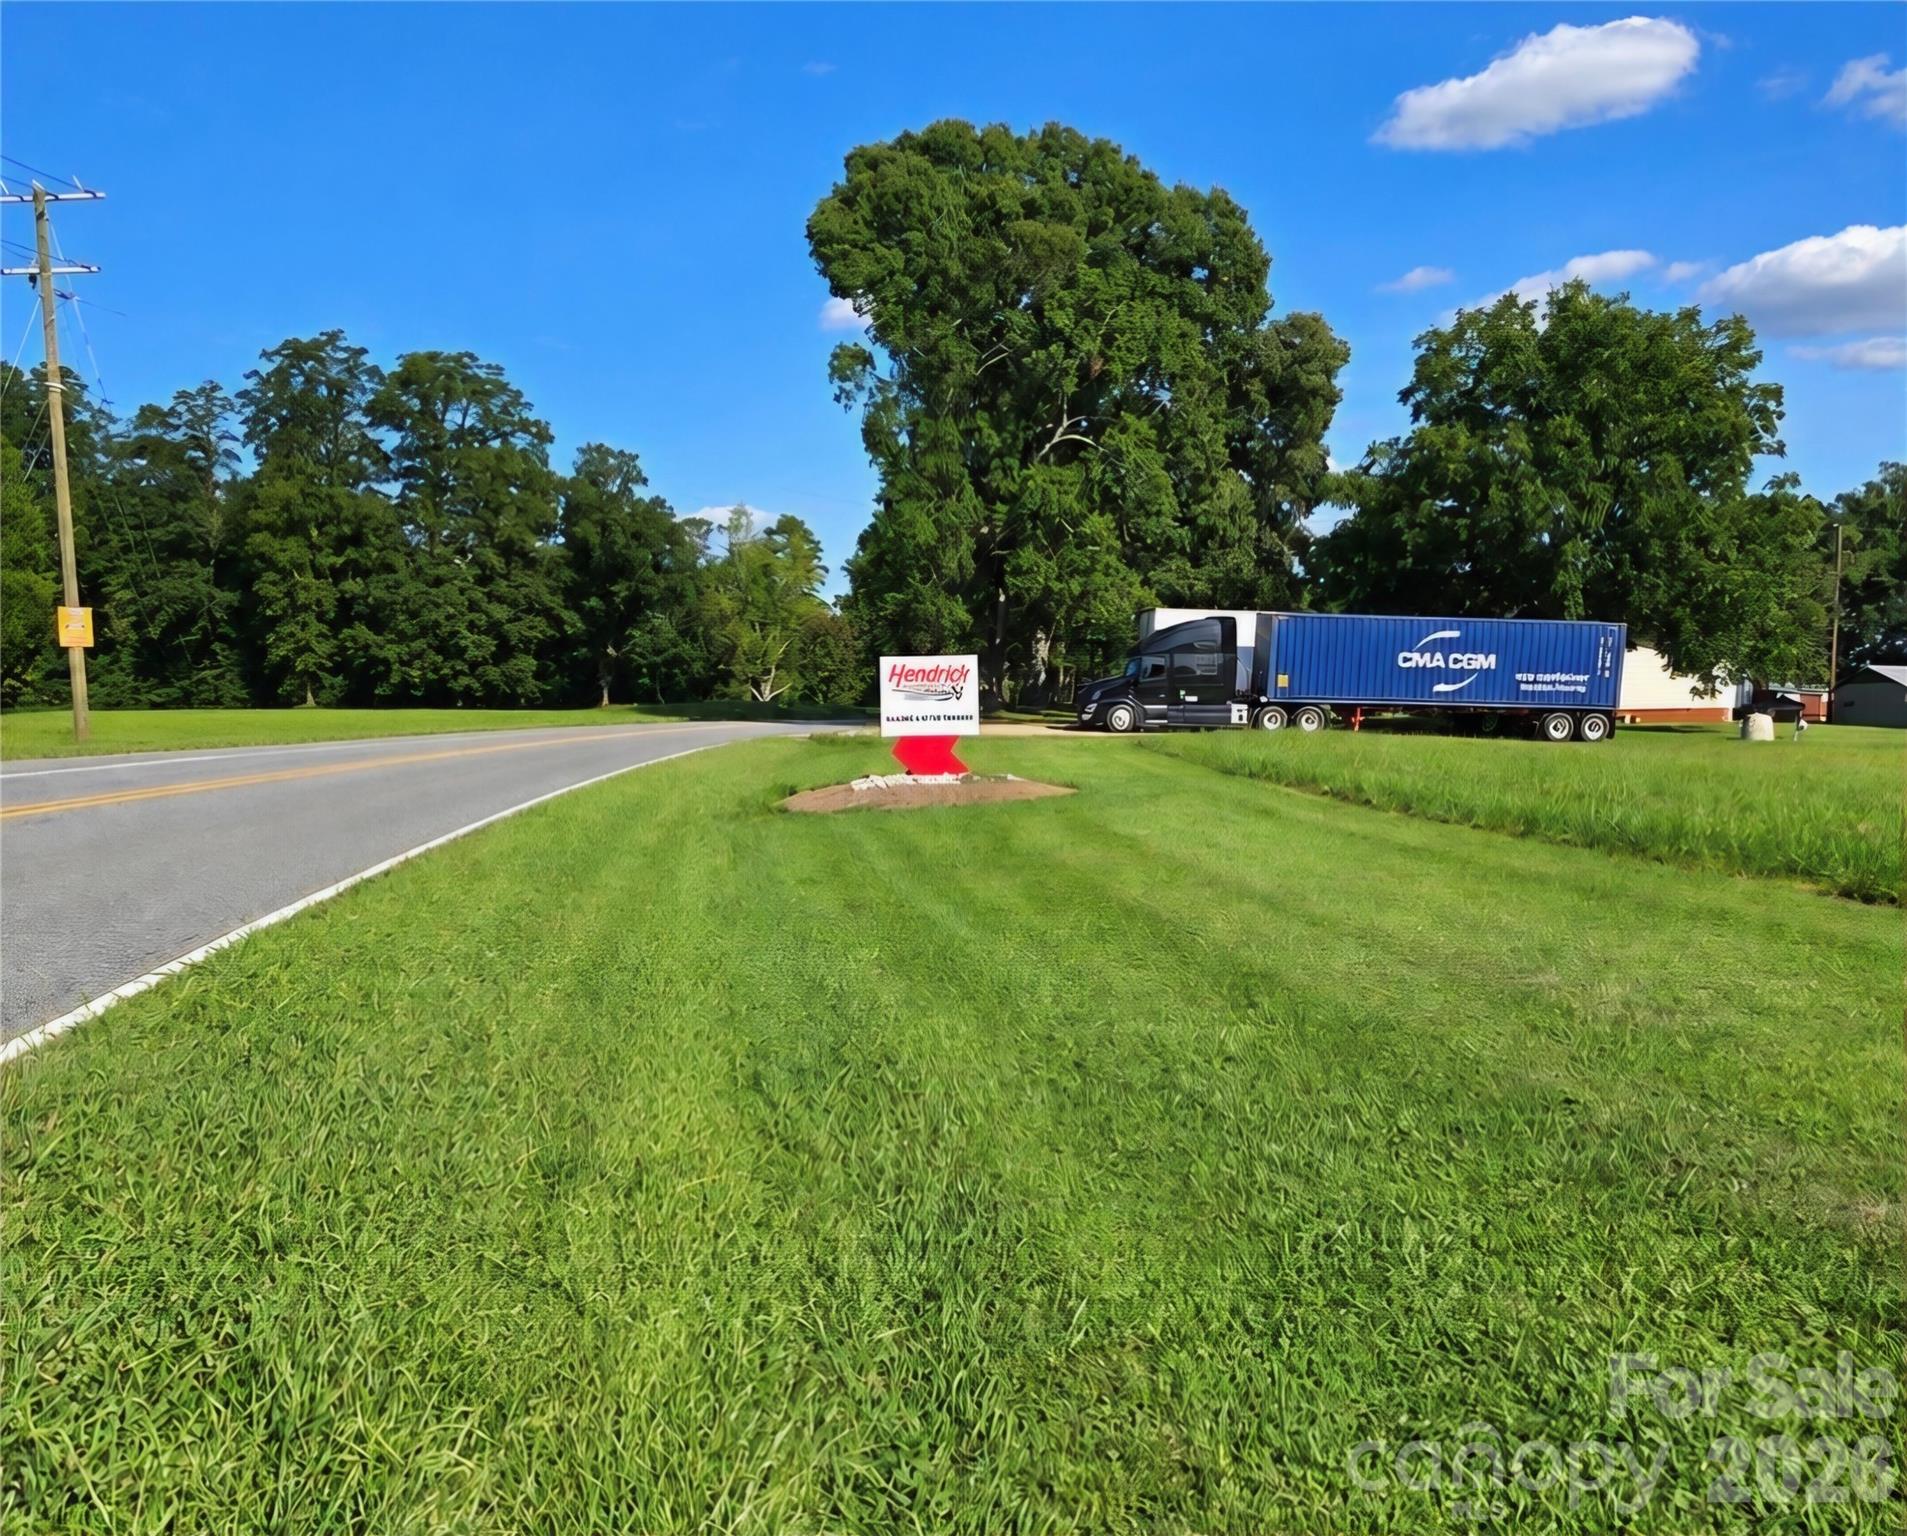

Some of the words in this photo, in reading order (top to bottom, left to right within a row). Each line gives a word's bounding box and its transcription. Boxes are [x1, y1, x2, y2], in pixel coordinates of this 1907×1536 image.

[1398, 651, 1446, 669] CMA
[1448, 653, 1496, 670] CGM
[888, 664, 970, 688] Hendrick
